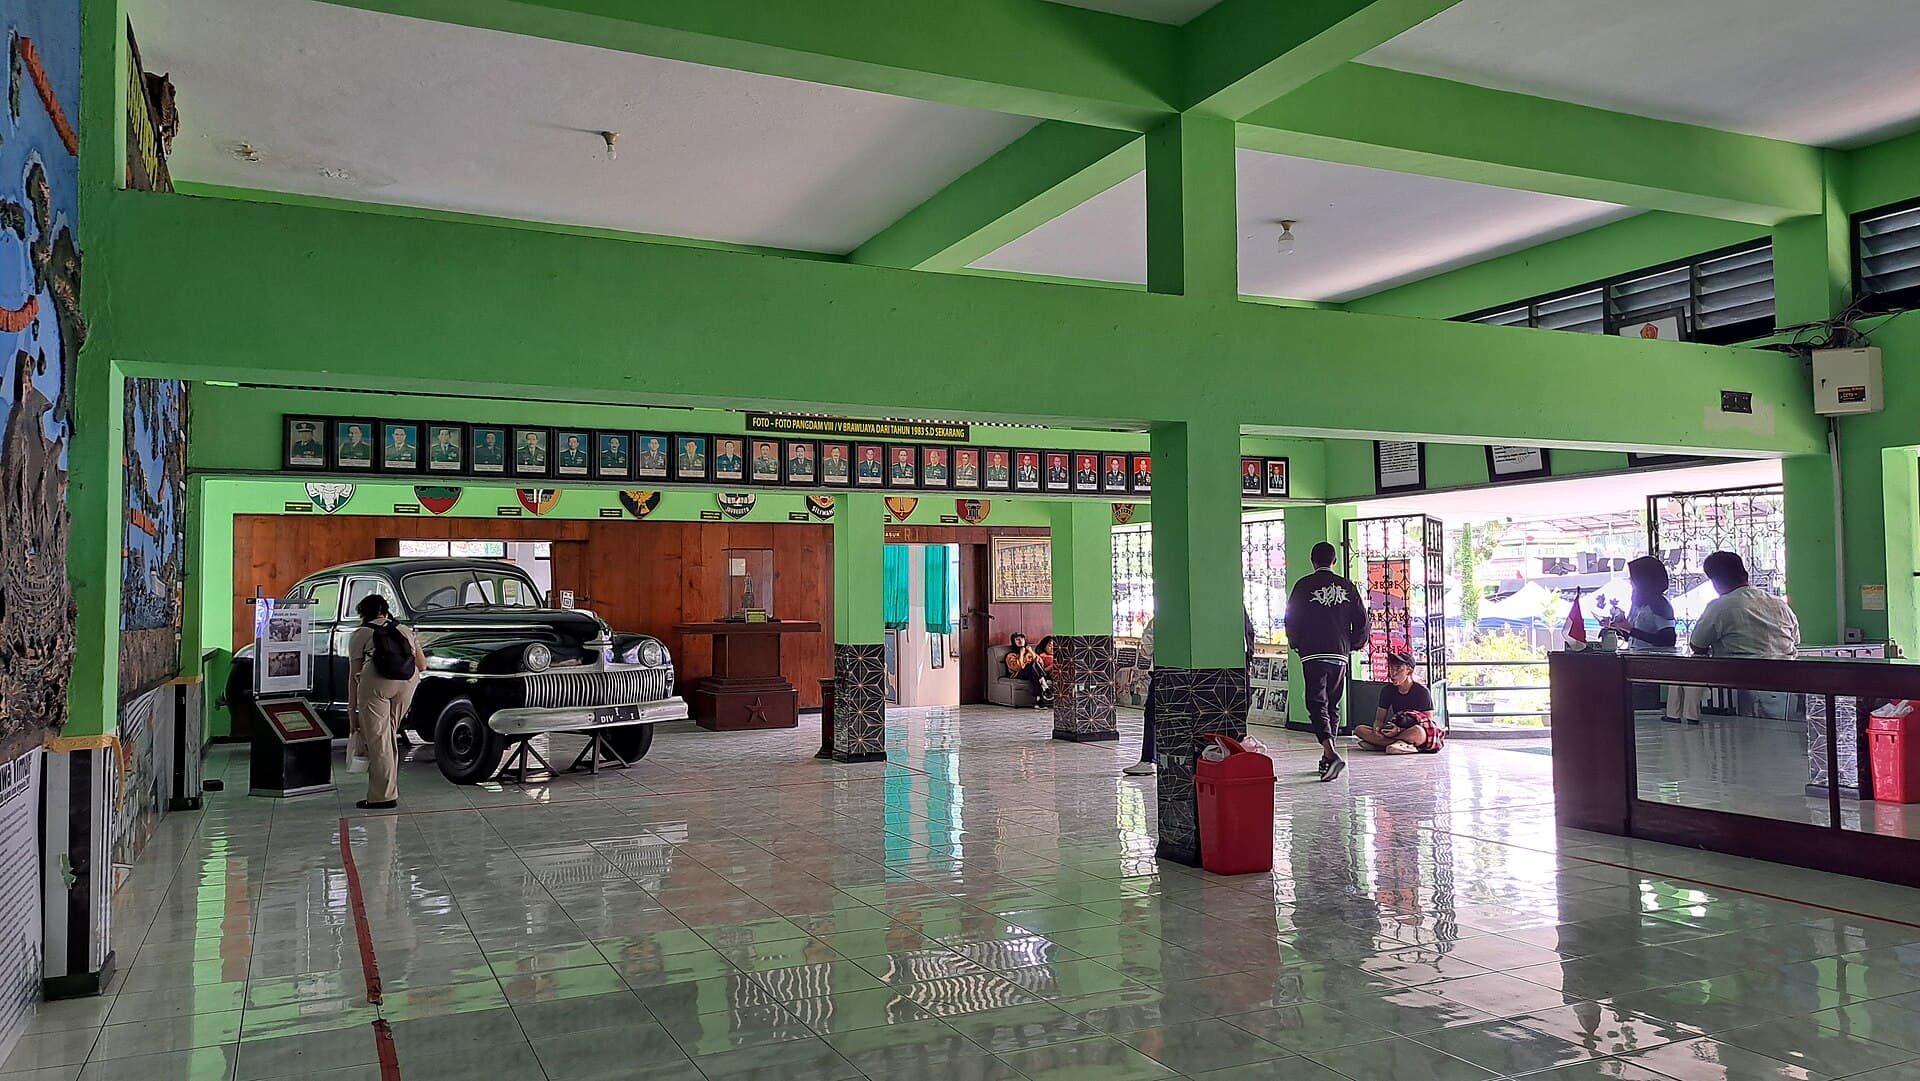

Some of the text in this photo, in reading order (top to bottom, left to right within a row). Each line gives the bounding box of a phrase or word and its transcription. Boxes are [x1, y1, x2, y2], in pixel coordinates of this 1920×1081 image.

[752, 417, 770, 427] FOTO
[775, 418, 792, 429] FOTO
[792, 419, 823, 431] PANGDAM
[823, 421, 834, 431] VIII
[837, 422, 843, 432] V
[843, 422, 876, 433] BRAWIJAYA
[876, 424, 891, 434] DARI
[890, 425, 911, 435] TAHUN
[911, 426, 925, 436] 1983
[935, 428, 965, 438] SEKARANG
[600, 715, 613, 723] DIV
